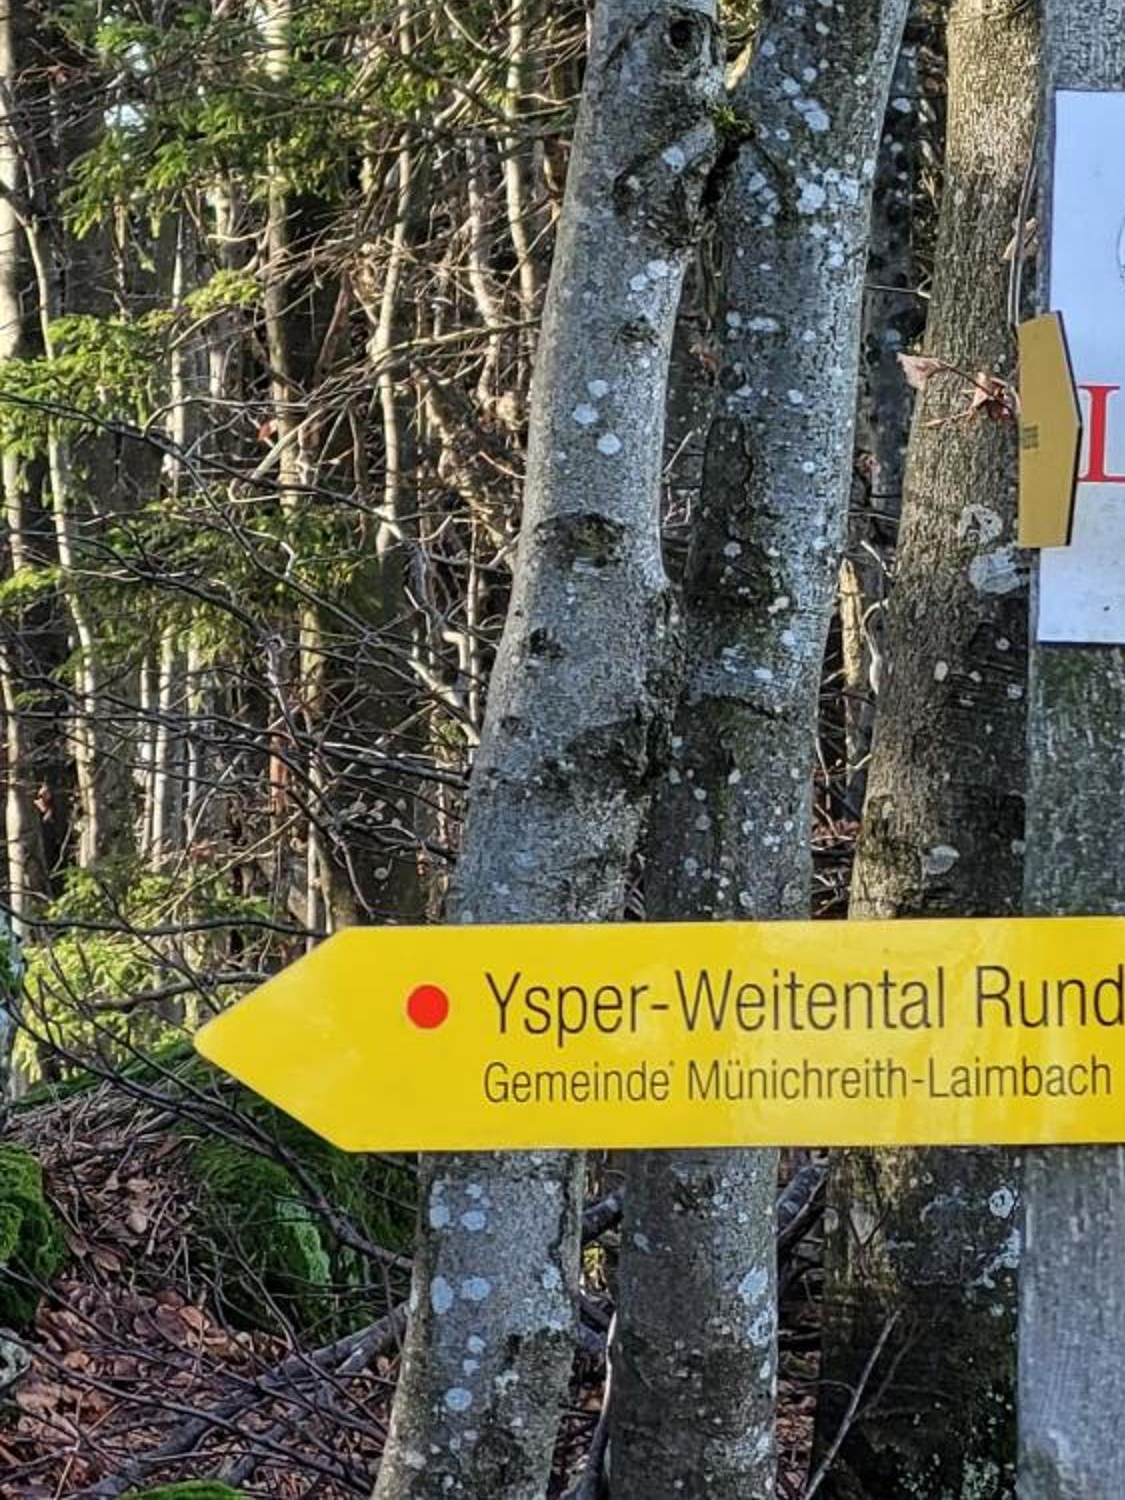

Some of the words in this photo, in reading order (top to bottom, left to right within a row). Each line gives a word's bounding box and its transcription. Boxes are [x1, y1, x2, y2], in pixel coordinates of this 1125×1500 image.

[484, 965, 945, 1047] Ysper-Weitental
[484, 1061, 670, 1104] Gemeinde
[688, 1054, 1111, 1102] Münichreith-Laimbach
